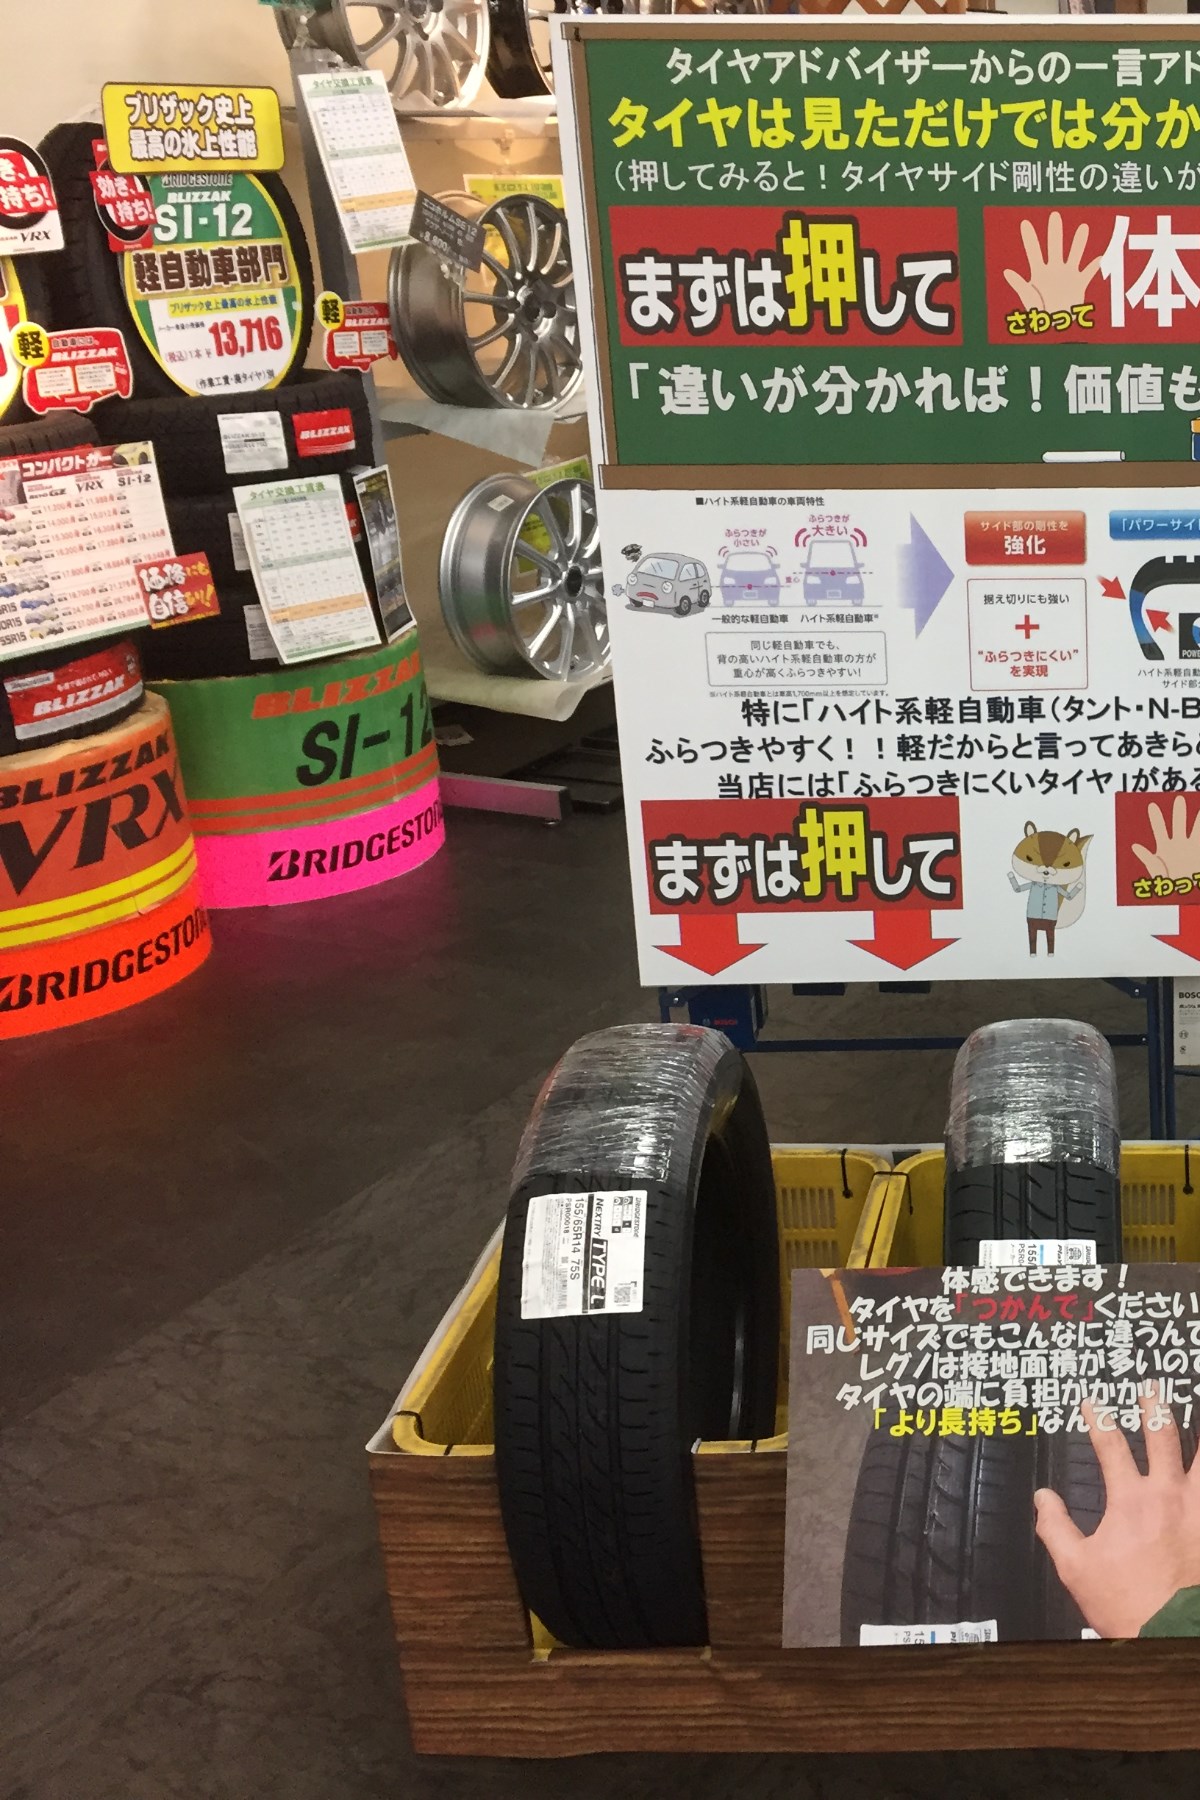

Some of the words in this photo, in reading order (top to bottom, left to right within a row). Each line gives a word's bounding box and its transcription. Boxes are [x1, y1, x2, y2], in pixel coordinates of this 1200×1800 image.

[125, 93, 254, 126] ブリザック史上
[128, 128, 258, 160] 最高の氷上性能
[167, 190, 231, 204] BLIZZAK
[154, 203, 253, 242] SI-12
[20, 230, 52, 242] VRX
[133, 245, 289, 294] 軽自動車部門
[624, 219, 953, 329] まずは押して
[321, 298, 341, 324] 軽
[1006, 303, 1096, 335] さわって
[16, 330, 45, 361] 軽
[208, 316, 283, 357] 13,716
[51, 346, 119, 362] BLIZZAK
[300, 424, 351, 441] BLIZZAK
[76, 479, 104, 494] VRX
[808, 513, 850, 524] ふらつきが
[980, 519, 1069, 532] サイド部の剛性を
[725, 528, 767, 538] ふらつきが
[812, 525, 848, 537] 大きい
[733, 538, 760, 548] 小さい
[1004, 534, 1047, 556] 強化
[139, 560, 210, 592] 価格にも
[983, 593, 1070, 605] 据え切りにも強い
[711, 613, 789, 624] 一般的な軽自動車
[750, 639, 841, 651] 同じ軽自動車でも、
[716, 653, 877, 665] 背の高いハイト系軽自動車の方が
[733, 667, 862, 679] 重心が高くふらつきやすい!
[1010, 664, 1049, 678] を実現
[33, 674, 125, 717] BLIZZAK
[0, 768, 185, 898] VRX
[654, 807, 954, 899] まずは押して
[572, 1197, 585, 1254] 155/65R14
[594, 1198, 605, 1237] NEXTRY
[569, 1258, 581, 1281] 75S
[941, 1264, 1128, 1295] 体感できます！
[874, 1405, 1192, 1437] 「より長持ち」なんですよ！
